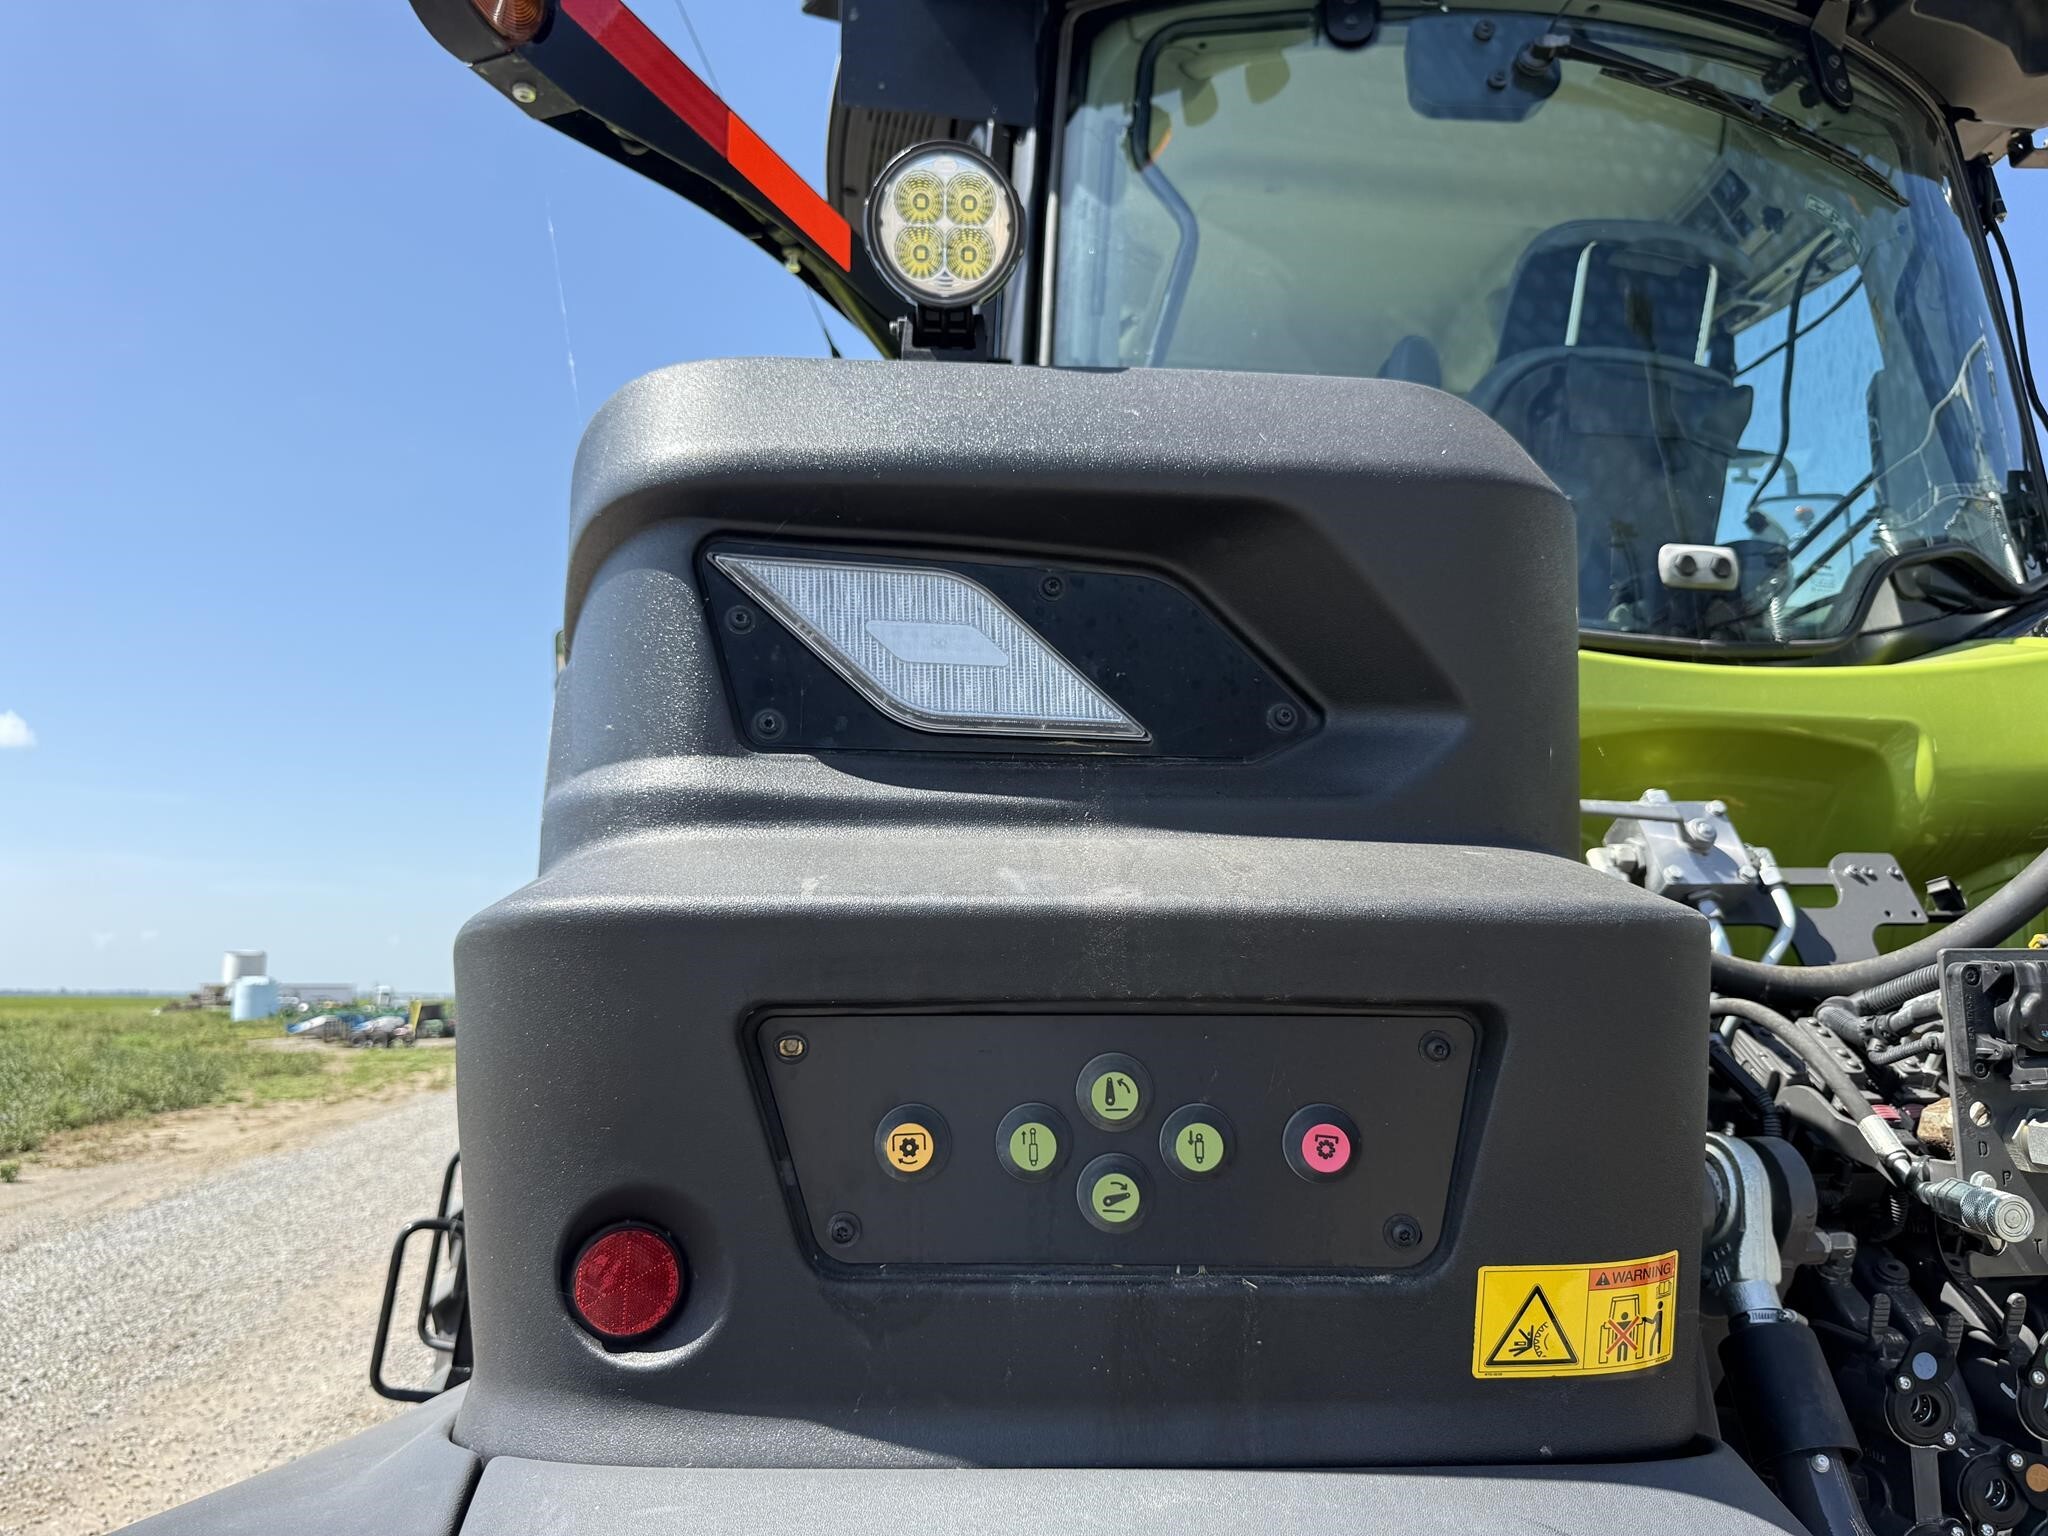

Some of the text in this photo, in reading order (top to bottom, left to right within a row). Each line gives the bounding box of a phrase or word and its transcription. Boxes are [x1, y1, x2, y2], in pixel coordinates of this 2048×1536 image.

[1978, 1141, 1989, 1157] D
[2002, 1170, 2012, 1187] P
[2033, 1239, 2043, 1255] T
[1612, 1263, 1671, 1284] WARNING
